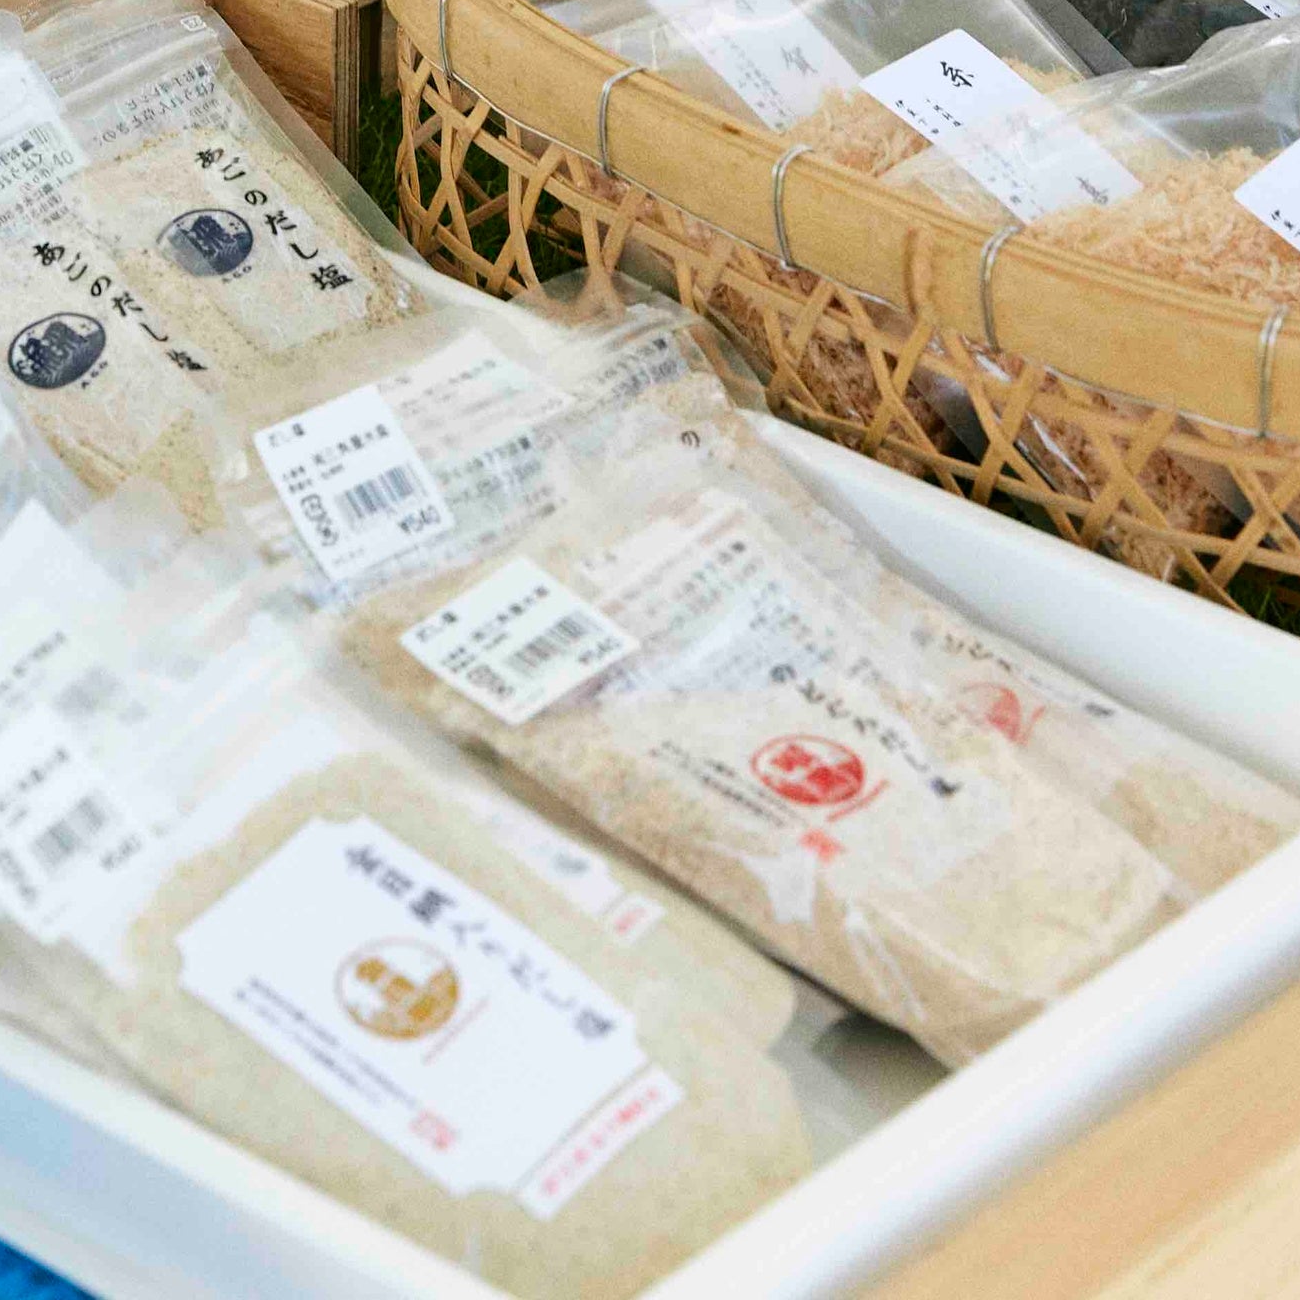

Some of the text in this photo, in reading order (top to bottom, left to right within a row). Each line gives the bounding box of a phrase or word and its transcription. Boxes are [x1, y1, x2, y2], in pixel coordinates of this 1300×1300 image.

[195, 146, 354, 292] あごのだし塩
[32, 241, 207, 372] あごのだし塩
